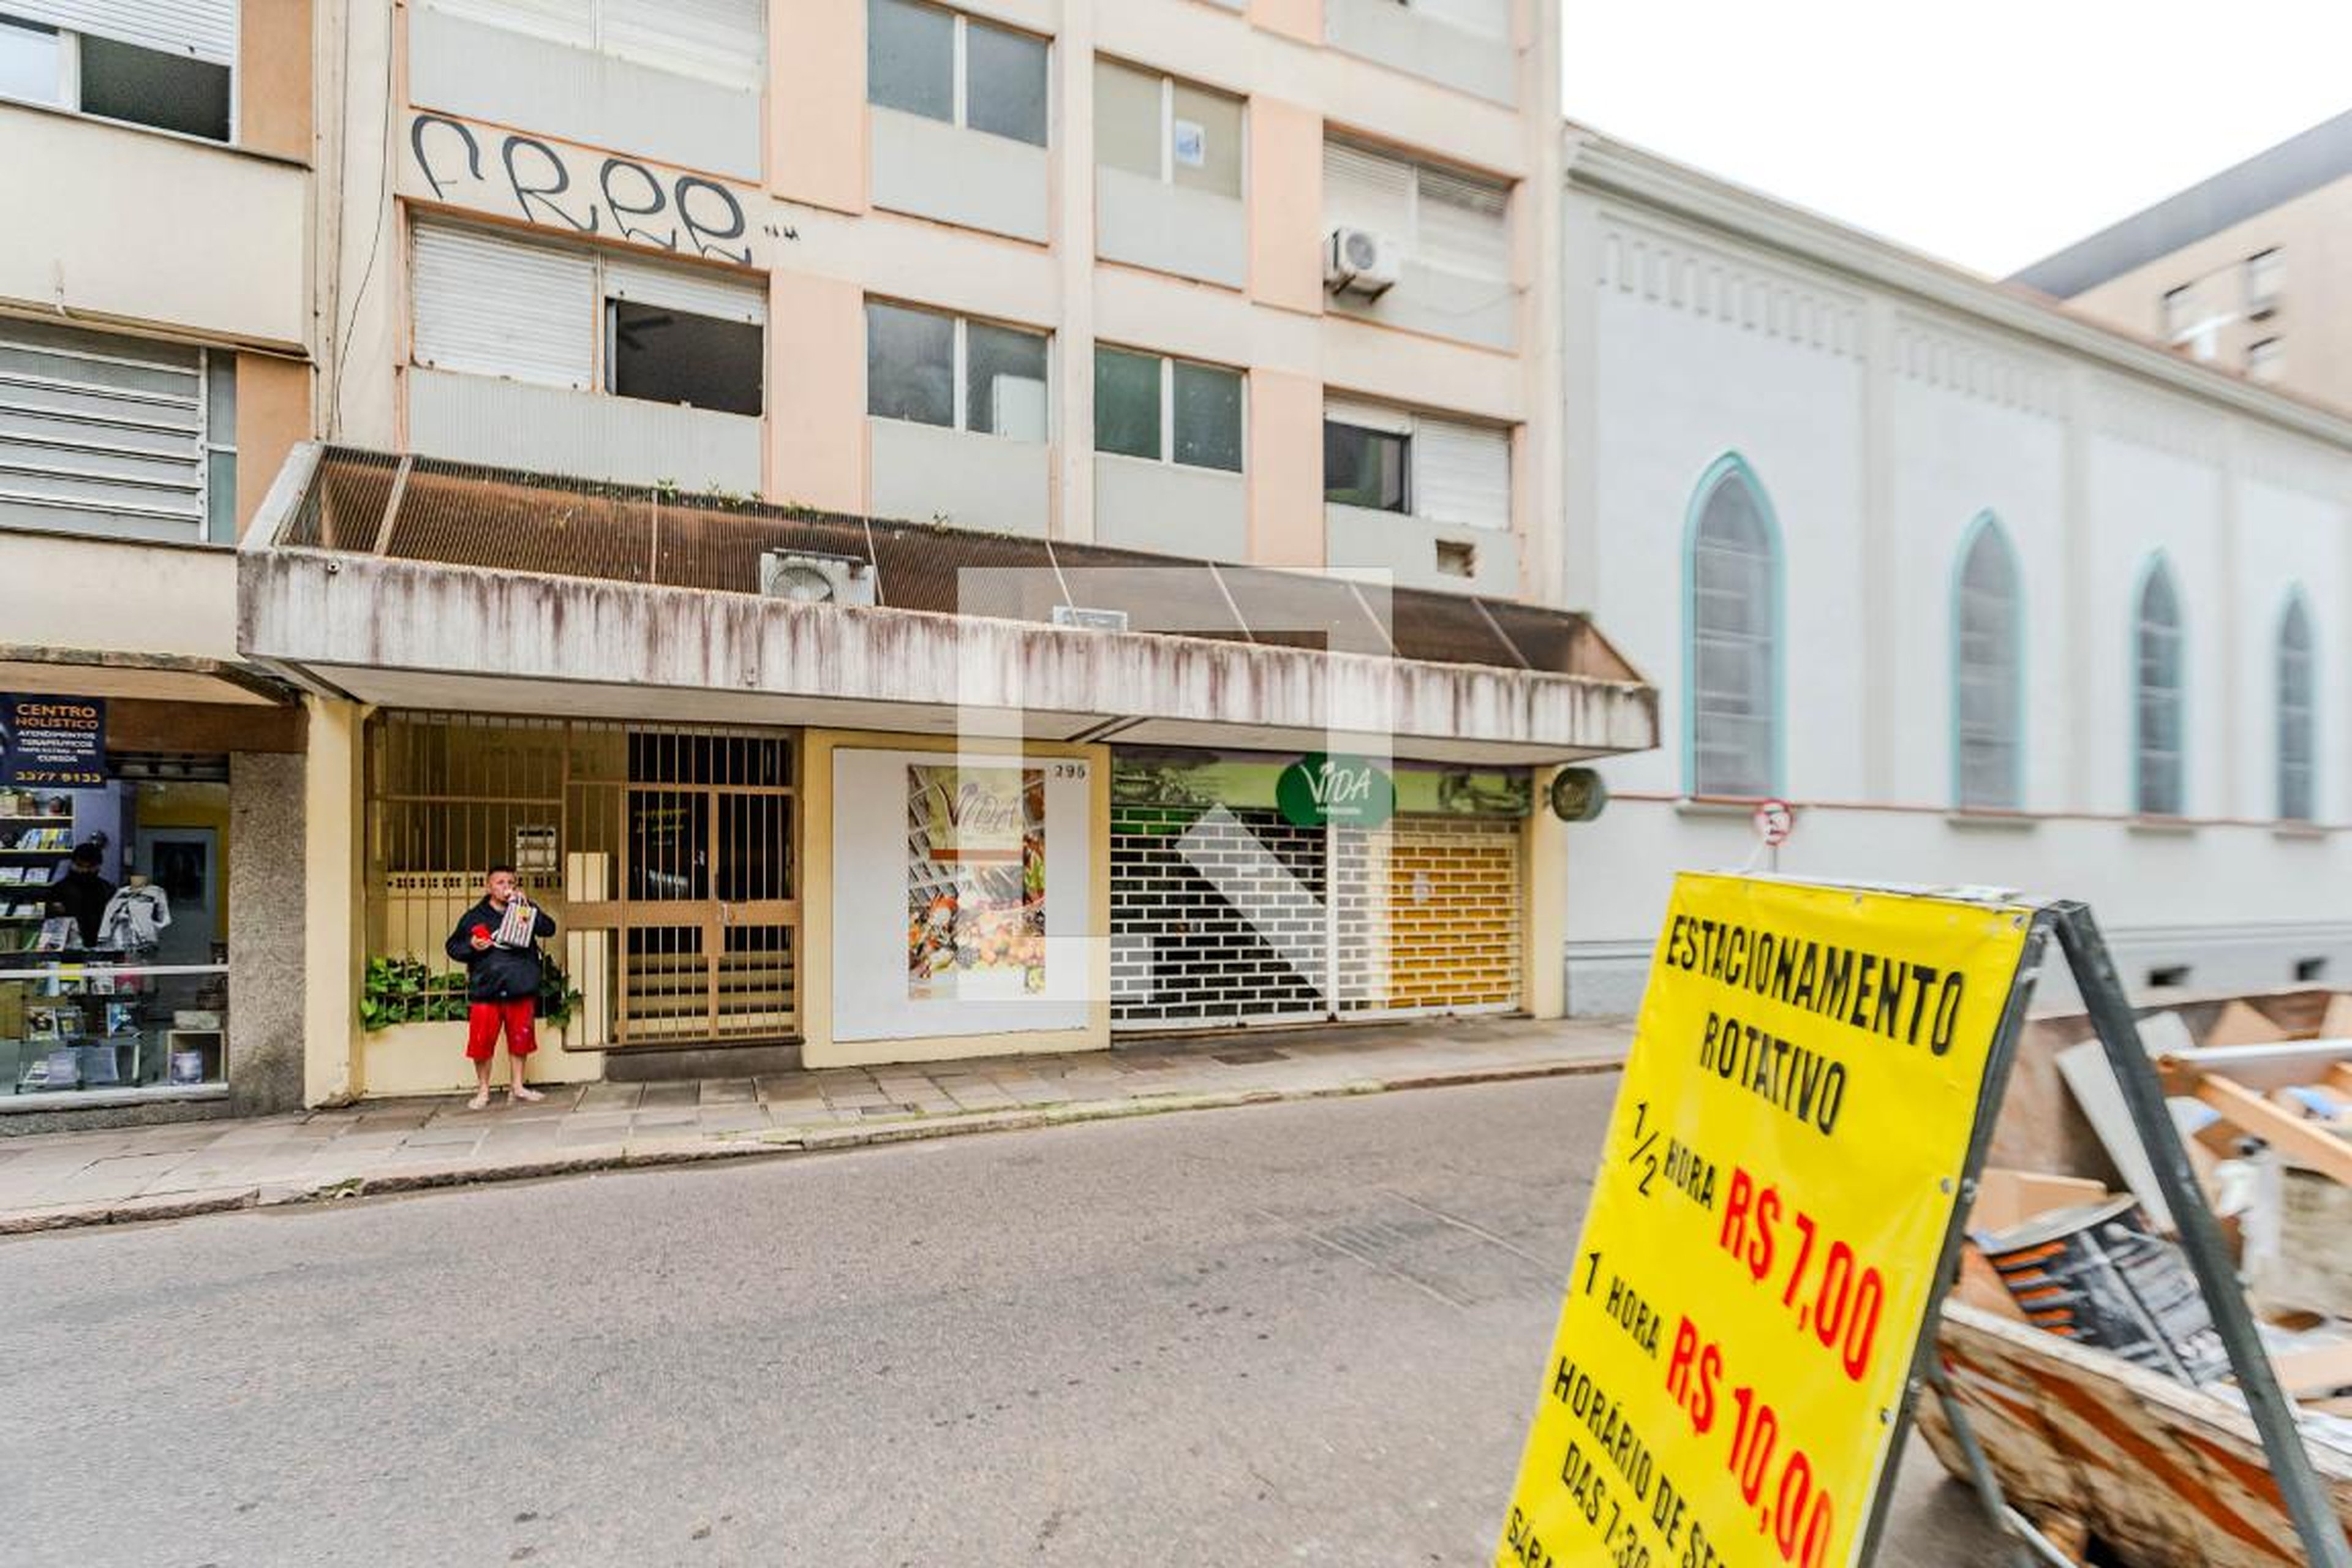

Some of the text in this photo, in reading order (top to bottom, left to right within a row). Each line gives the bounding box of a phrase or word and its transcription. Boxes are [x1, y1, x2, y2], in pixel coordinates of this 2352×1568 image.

[17, 704, 96, 718] CENTRO
[1298, 761, 1371, 804] VIDA
[1666, 915, 1965, 1056] ESTACIONAMENTO
[1700, 1011, 1847, 1136] ROTATIVO
[1585, 1253, 1601, 1295] 1
[1605, 1275, 1662, 1360] HORA
[1664, 1137, 1716, 1210] HORA
[1783, 1212, 1885, 1382] 7,00
[1553, 1355, 1655, 1502] HORÁRIO
[1652, 1473, 1686, 1551] DE
[1562, 1440, 1606, 1526] DAS
